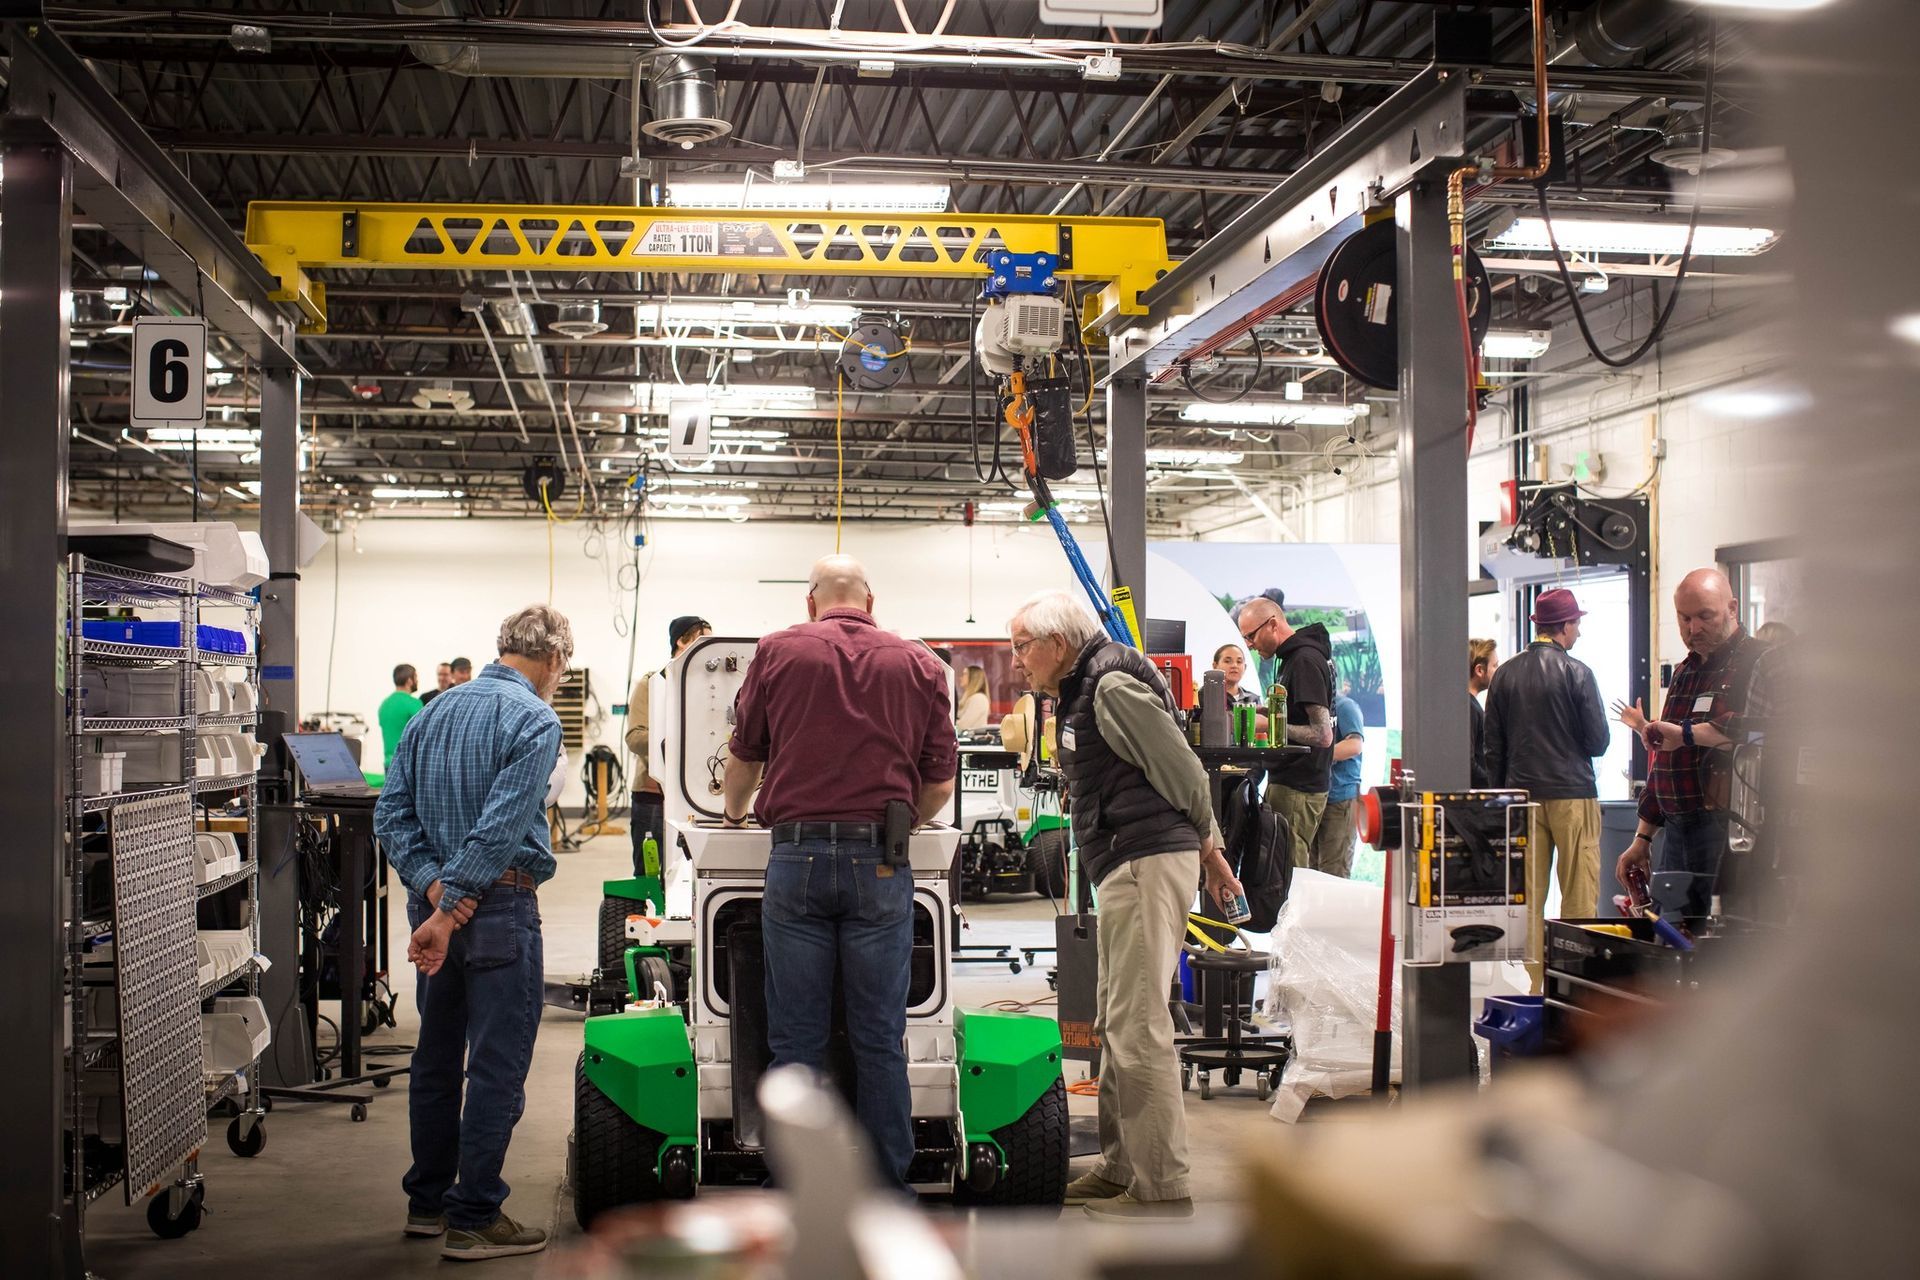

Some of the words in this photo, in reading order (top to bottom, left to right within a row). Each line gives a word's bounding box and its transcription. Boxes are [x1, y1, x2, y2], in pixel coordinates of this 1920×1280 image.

[653, 233, 672, 243] RATED
[648, 243, 676, 253] CAPACITY
[149, 338, 190, 404] 6
